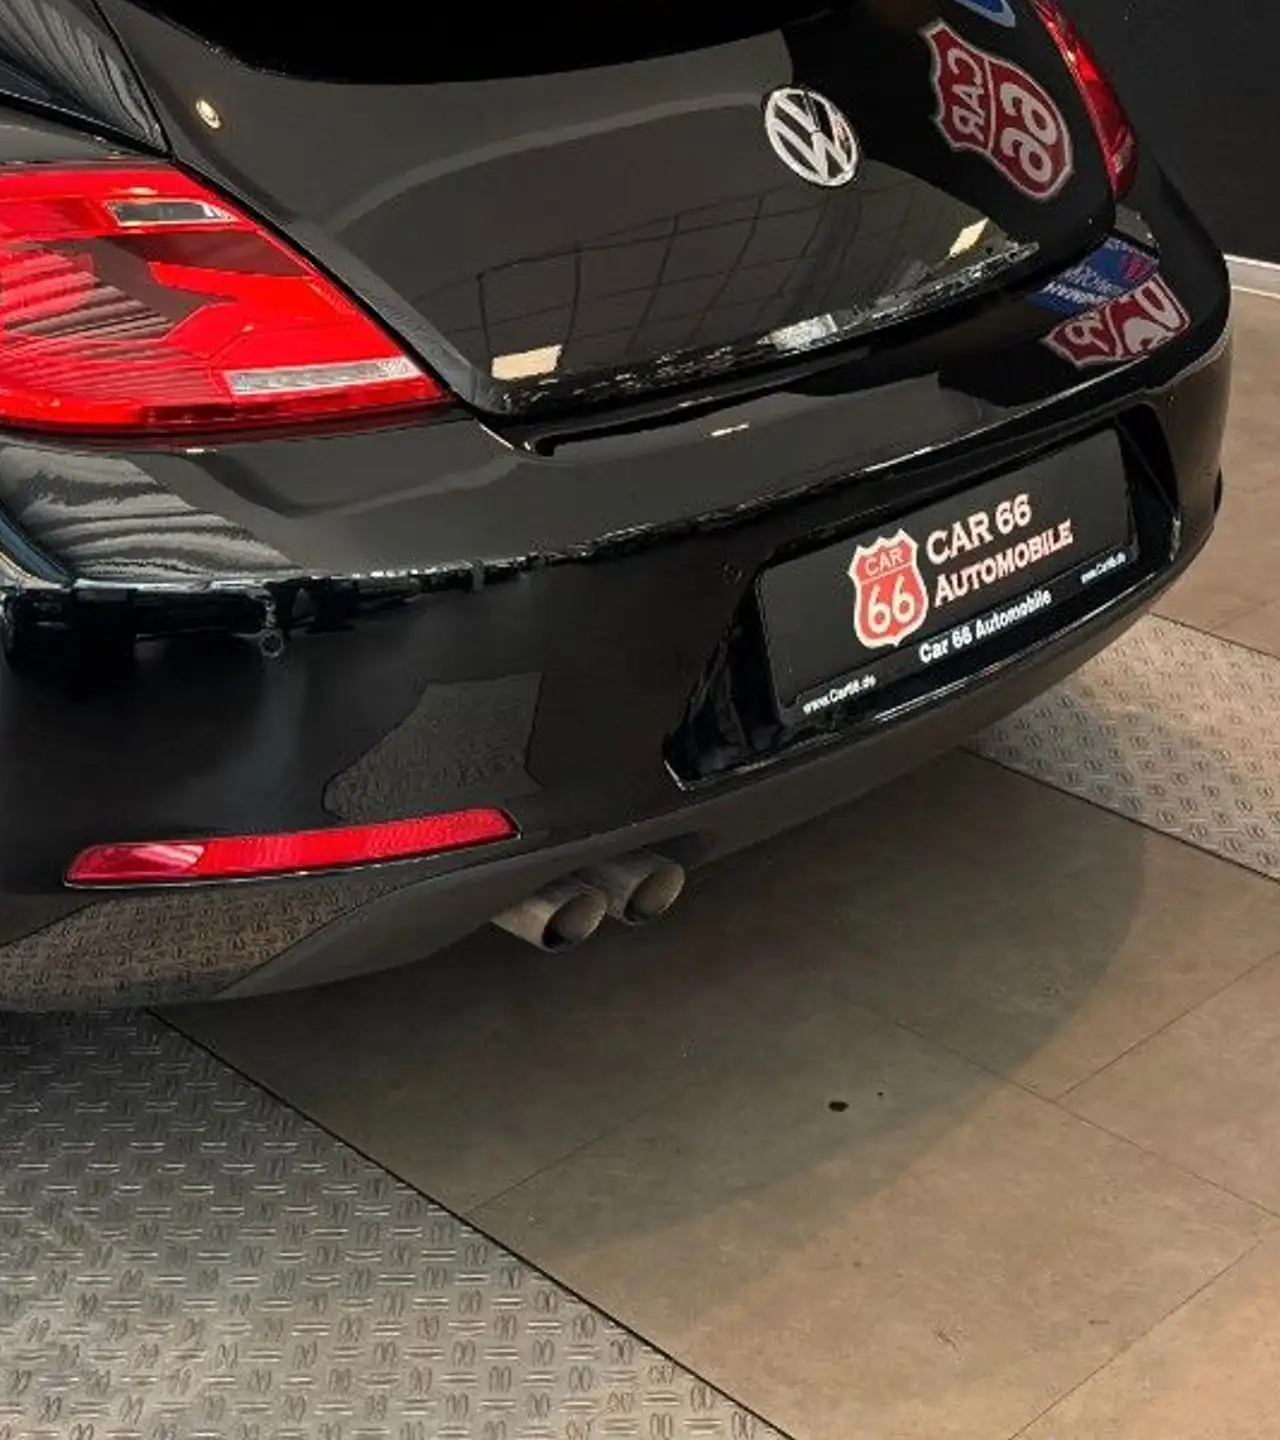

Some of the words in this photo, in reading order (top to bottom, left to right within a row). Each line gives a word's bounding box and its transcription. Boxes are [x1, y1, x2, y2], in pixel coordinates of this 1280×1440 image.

[865, 547, 904, 576] CAR
[926, 511, 993, 565] CAR
[995, 493, 1032, 535] 66
[934, 518, 1074, 608] AUTOMOBILE
[867, 574, 915, 634] 66
[919, 637, 949, 664] Car
[975, 589, 1052, 640] Automobile
